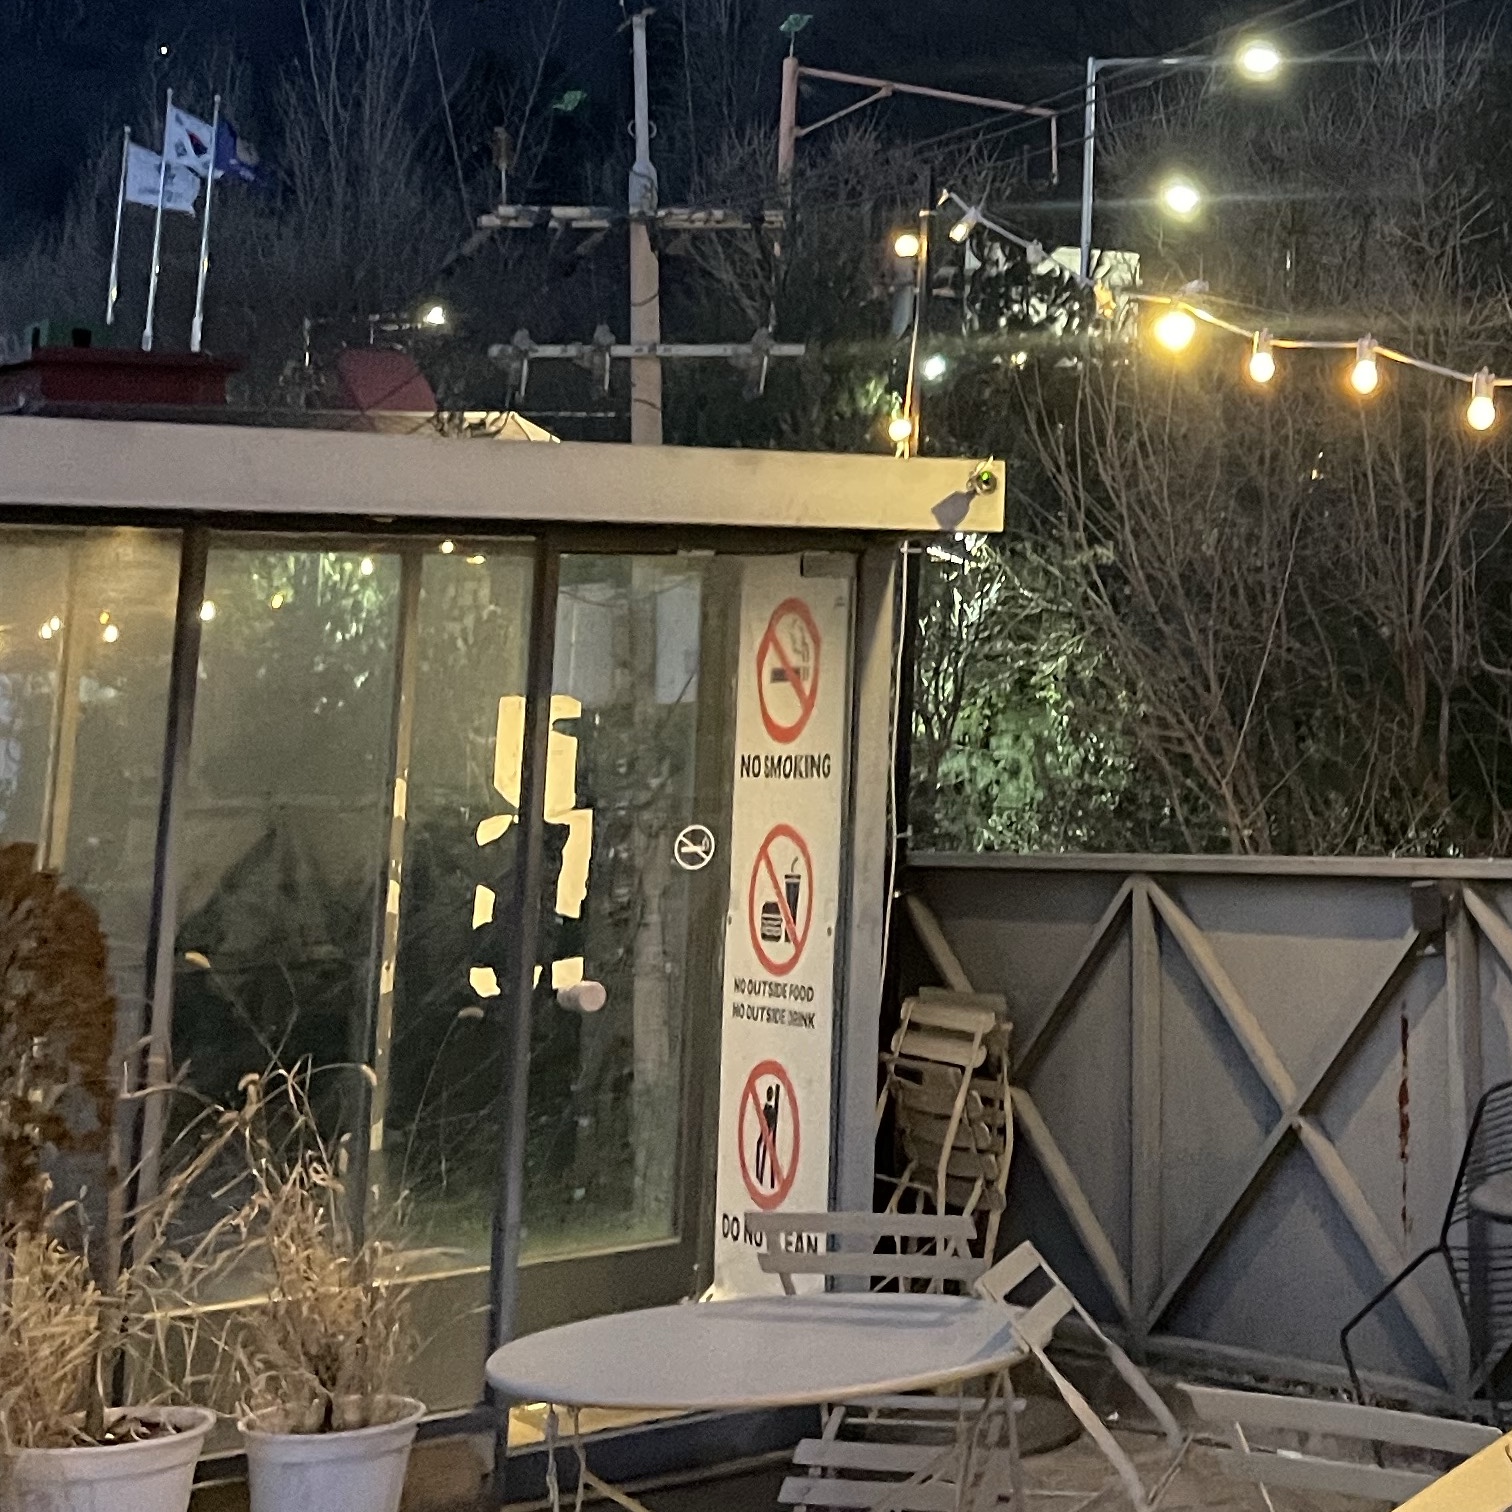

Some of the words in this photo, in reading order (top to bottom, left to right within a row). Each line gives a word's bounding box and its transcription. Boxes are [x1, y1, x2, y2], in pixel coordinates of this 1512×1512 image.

[740, 753, 761, 778] NO
[763, 753, 831, 779] SMOKING
[733, 977, 746, 994] NO
[747, 978, 788, 999] OUTSIDE
[789, 983, 815, 1002] FOOD
[732, 1002, 745, 1019] NO
[746, 1004, 787, 1025] OUTSIDE
[787, 1009, 815, 1029] DRINK
[722, 1213, 740, 1242] DO
